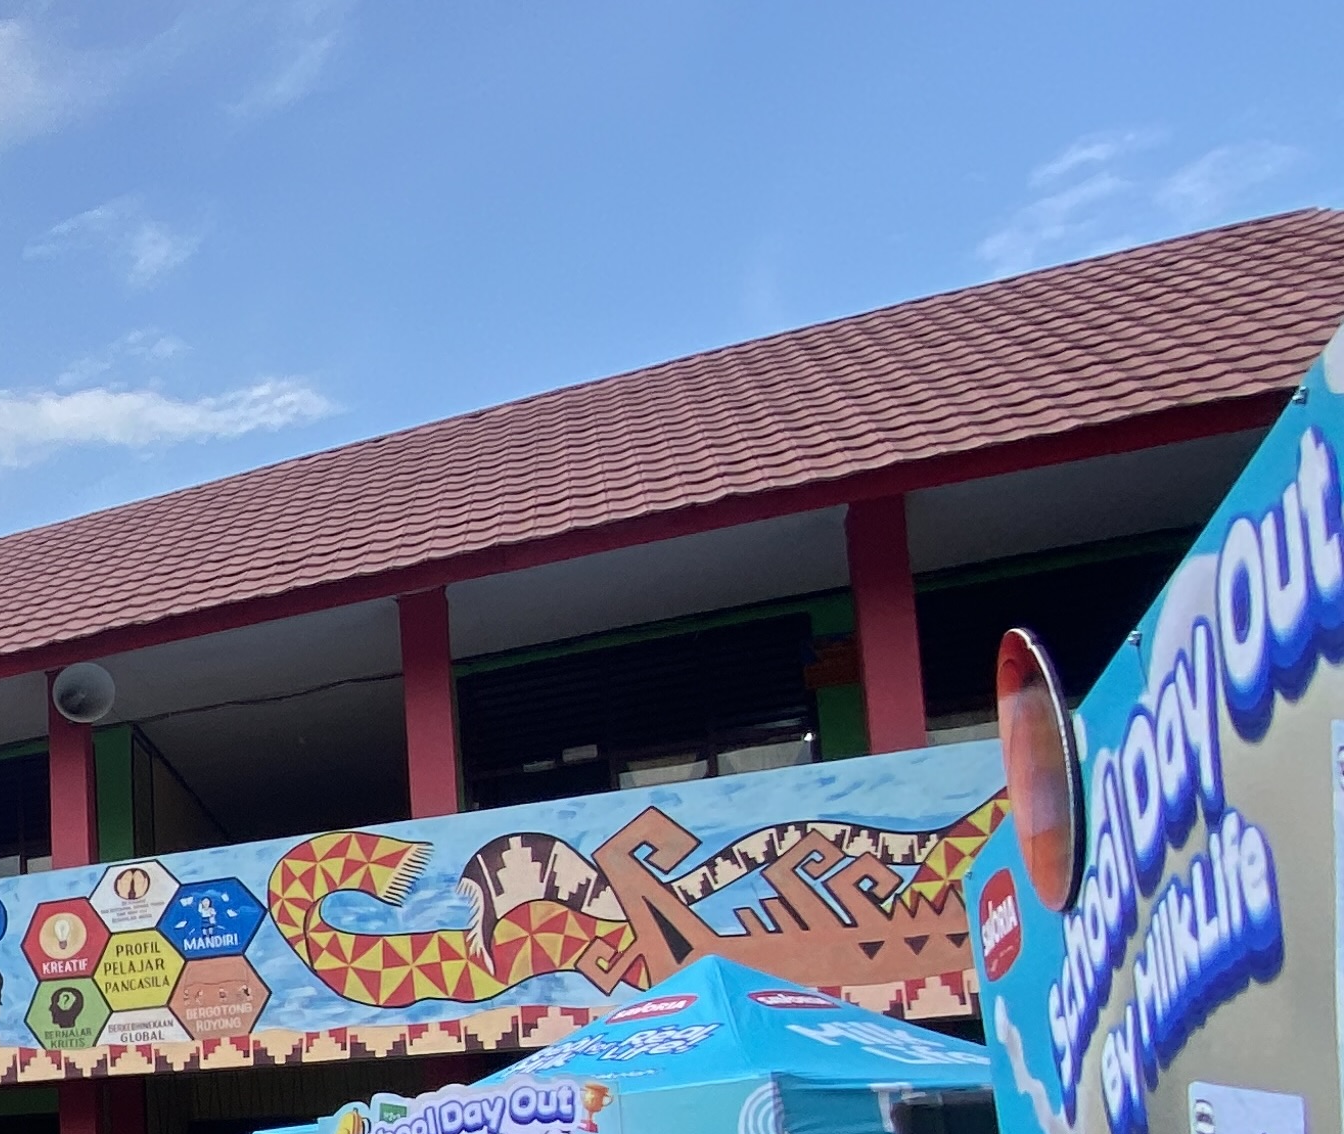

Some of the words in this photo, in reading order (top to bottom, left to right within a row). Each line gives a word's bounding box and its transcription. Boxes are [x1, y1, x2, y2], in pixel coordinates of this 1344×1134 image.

[1121, 619, 1223, 890] Day
[1217, 425, 1344, 730] Out
[116, 941, 161, 957] PROFIL
[183, 933, 239, 951] MANDIRI
[42, 957, 89, 975] KREATIF
[103, 958, 165, 976] PELAJAR
[104, 975, 170, 994] PANCASILA
[186, 1004, 253, 1020] BERGOTONG
[196, 1018, 242, 1032] ROYONG
[785, 1021, 946, 1047] Milk
[50, 1038, 85, 1049] KRITIS
[120, 1030, 165, 1043] GLOBAL
[508, 1084, 578, 1125] Out
